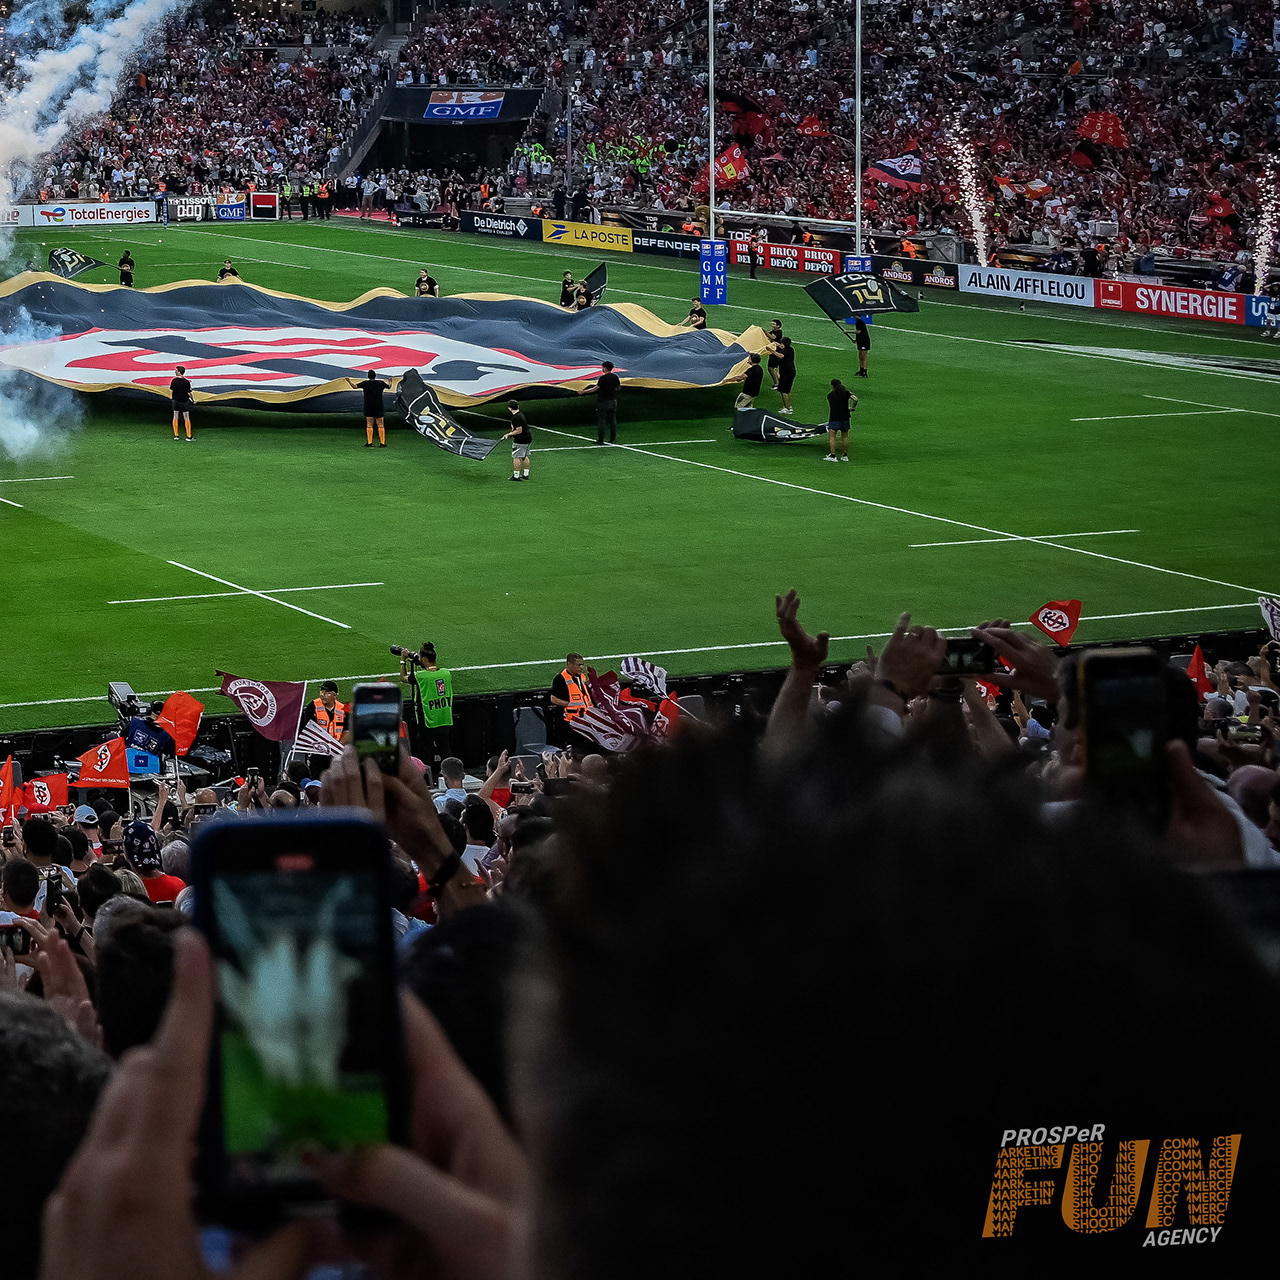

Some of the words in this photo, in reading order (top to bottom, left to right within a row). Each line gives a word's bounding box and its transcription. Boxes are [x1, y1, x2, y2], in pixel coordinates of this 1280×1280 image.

[431, 105, 496, 117] GMF
[68, 207, 150, 222] TotalEnergies
[218, 207, 243, 218] GMF
[473, 216, 485, 228] De
[486, 217, 516, 231] Dietrich
[574, 228, 588, 241] LA
[591, 231, 629, 246] POSTE
[633, 236, 700, 252] DEFENDER
[736, 242, 764, 254] BRO
[770, 246, 798, 257] BRICO
[805, 250, 833, 261] BRICO
[736, 254, 764, 267] DET
[883, 270, 912, 281] ANDROS
[924, 275, 954, 285] ANDROS
[967, 272, 1010, 291] ALAIN
[1013, 277, 1086, 300] AFFLELOU
[852, 288, 885, 303] 14
[1135, 287, 1237, 320] SYNERGIE
